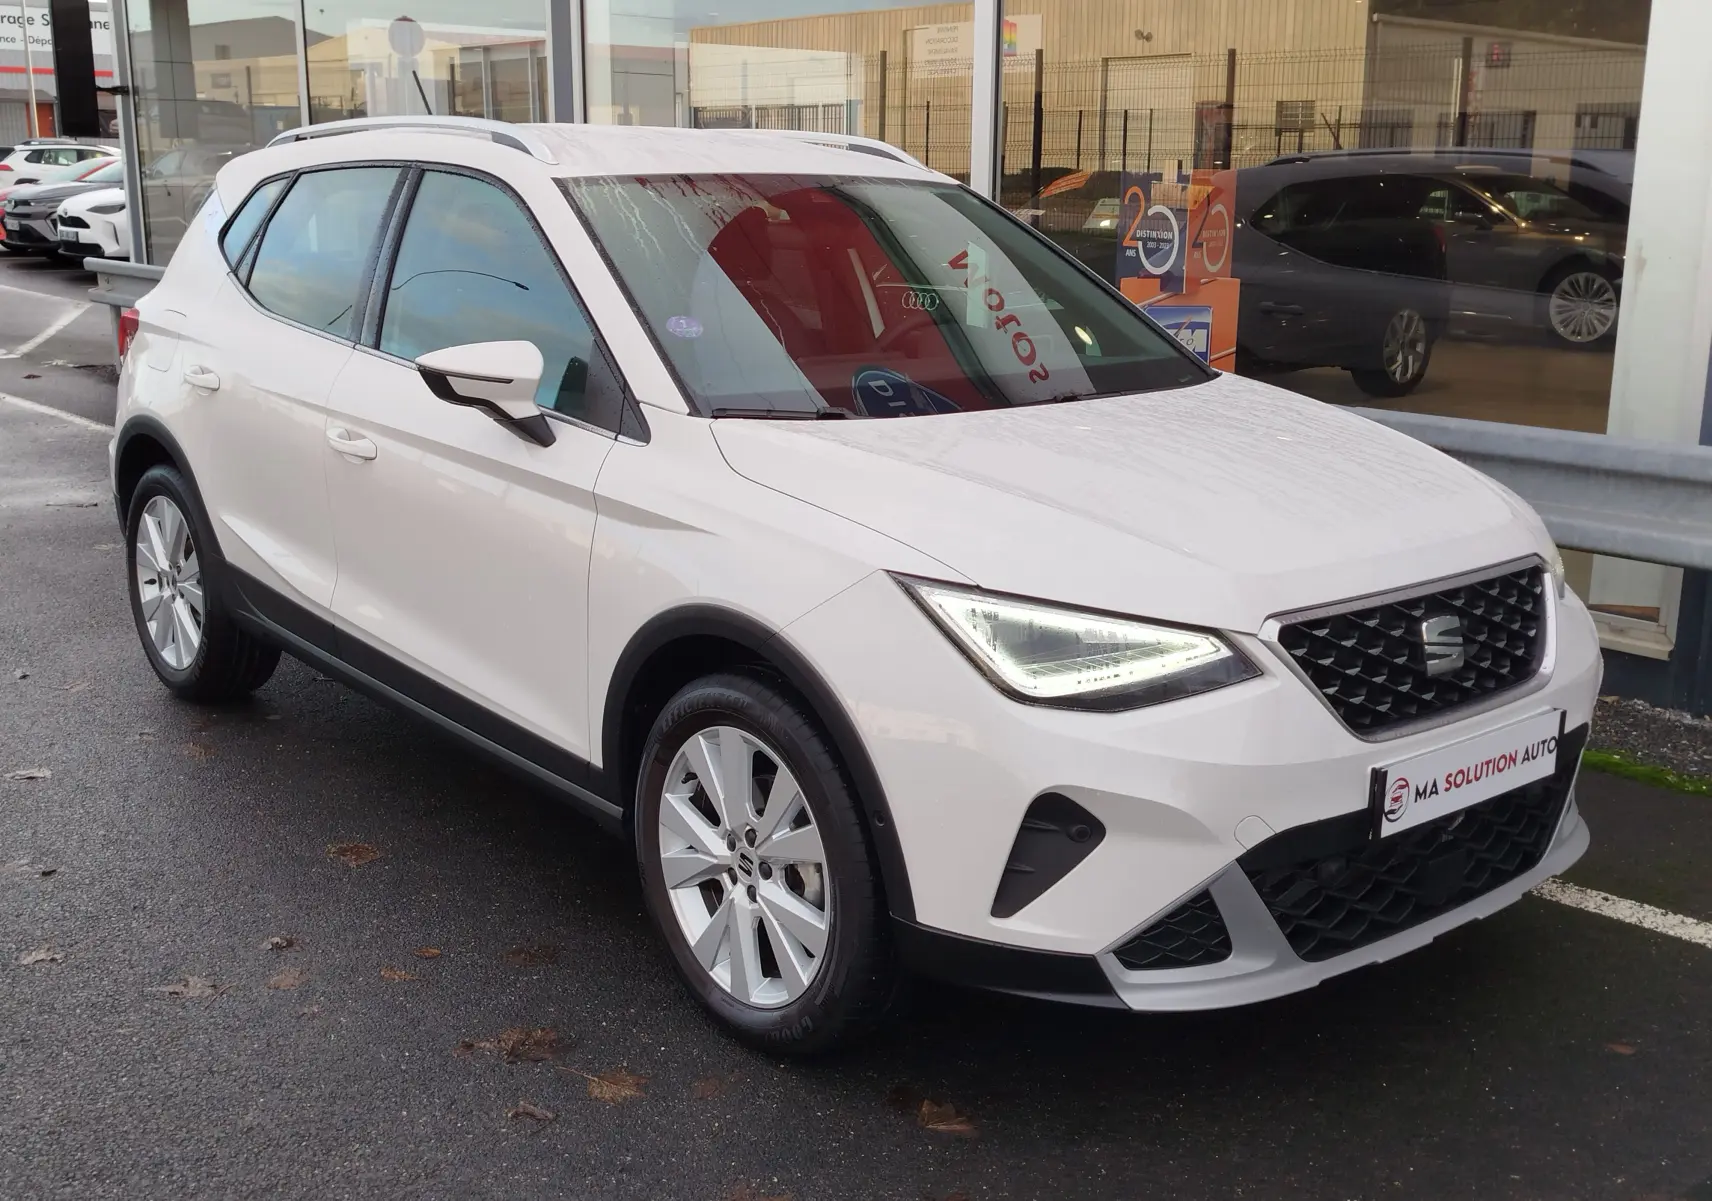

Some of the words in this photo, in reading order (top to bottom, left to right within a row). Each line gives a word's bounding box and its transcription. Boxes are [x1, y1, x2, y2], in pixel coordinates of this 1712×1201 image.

[1136, 230, 1173, 240] DISTINXION
[1125, 248, 1137, 258] ANS
[1414, 777, 1440, 803] MA
[1443, 749, 1519, 793] SOLUTION
[1520, 735, 1558, 765] AUTO
